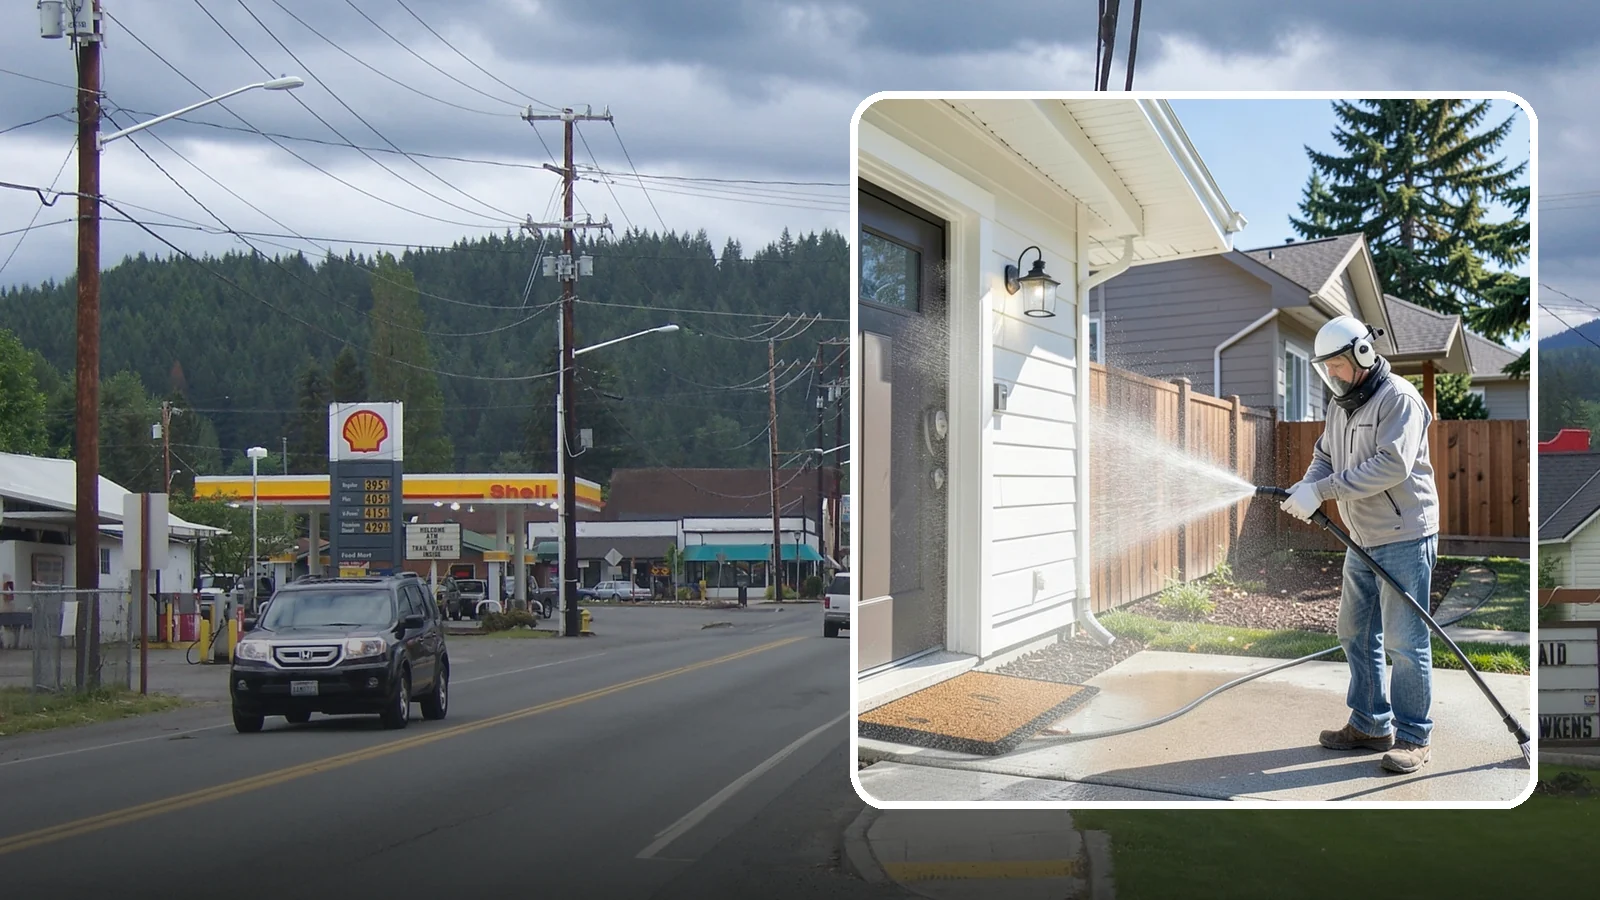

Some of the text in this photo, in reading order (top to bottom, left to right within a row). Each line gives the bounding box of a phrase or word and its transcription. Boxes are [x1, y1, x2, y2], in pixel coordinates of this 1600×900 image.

[365, 480, 384, 490] 395
[489, 484, 548, 499] Shell
[365, 494, 384, 504] 405
[365, 508, 384, 518] 415
[365, 522, 384, 533] 429
[1538, 643, 1567, 665] AID
[1538, 716, 1592, 739] WKENS
